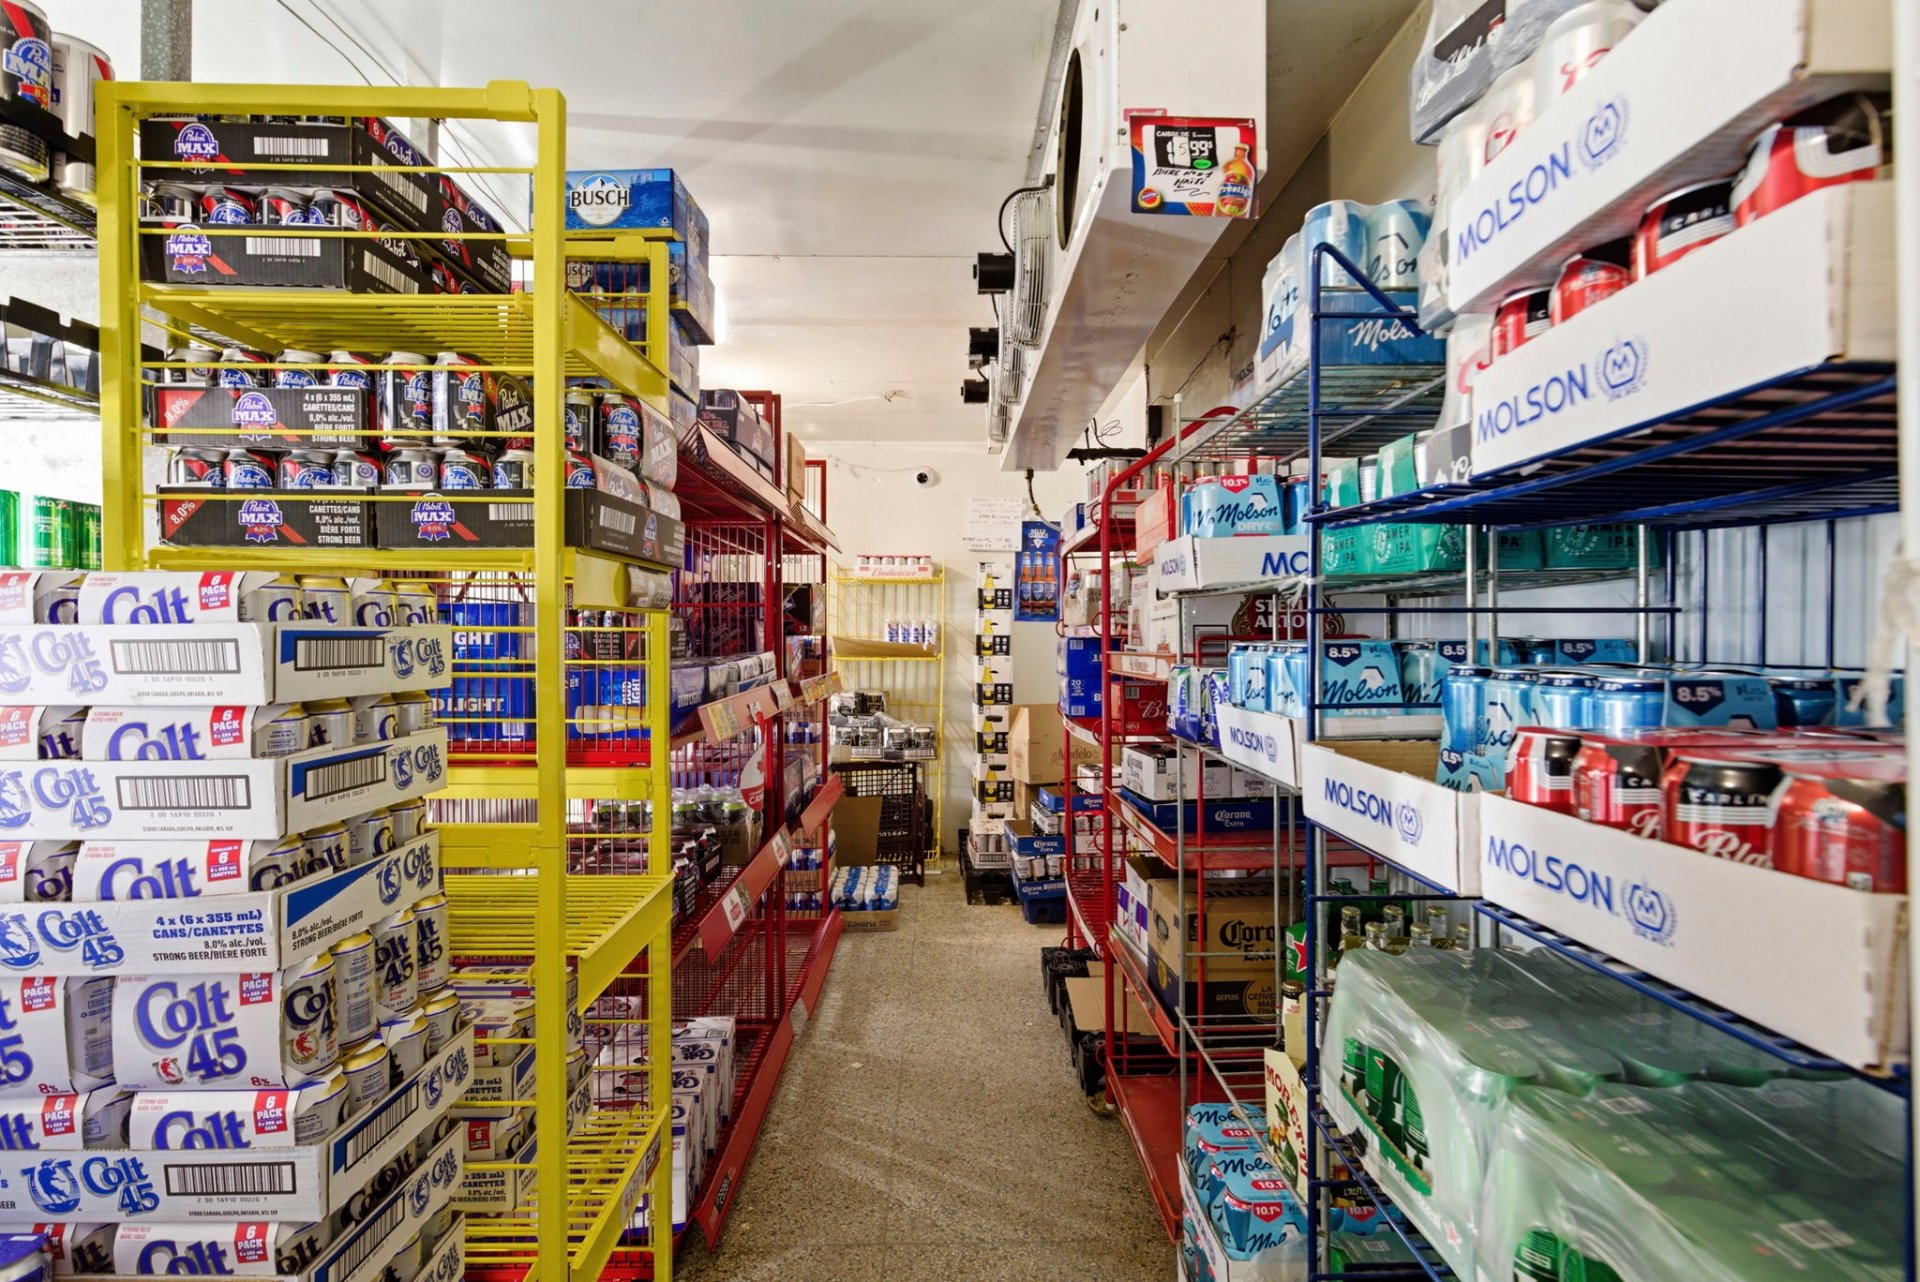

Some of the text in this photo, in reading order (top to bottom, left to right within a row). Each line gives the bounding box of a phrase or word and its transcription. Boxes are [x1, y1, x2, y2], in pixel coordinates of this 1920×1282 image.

[186, 130, 207, 142] Pabst
[177, 142, 217, 154] MAX
[571, 189, 630, 209] BUSCH
[1456, 142, 1570, 266] MOLSON
[1670, 201, 1728, 231] CARL
[170, 243, 209, 255] MAX
[337, 373, 363, 388] Pabst
[164, 397, 190, 423] 8.0%
[241, 400, 263, 412] Pabst
[303, 403, 355, 412] CANETTES/CANS
[1476, 363, 1590, 446] MOLSON
[234, 411, 274, 422] MAX
[497, 407, 530, 431] MAX
[606, 423, 640, 436] MAX
[235, 472, 260, 485] Pabst
[1222, 478, 1248, 487] 10.1%
[170, 500, 195, 525] 8.0%
[249, 502, 270, 512] Pabst
[309, 506, 360, 514] CANETTES/CANS
[1214, 503, 1279, 525] Molson
[241, 512, 279, 523] MAX
[413, 512, 452, 522] MAX
[341, 525, 360, 533] FORTE
[1237, 521, 1263, 532] DRY
[343, 535, 360, 543] BEER
[1607, 537, 1636, 549] IPA
[1396, 541, 1411, 554] IPA
[871, 567, 917, 578] Budweiser
[211, 575, 221, 586] 6
[201, 585, 227, 596] PACK
[454, 632, 494, 646] GHT
[31, 630, 96, 674] Colt
[415, 637, 443, 666] Colt
[1329, 646, 1360, 658] 8.5%
[1443, 644, 1467, 656] 8.5
[1563, 642, 1594, 653] 8.5%
[429, 656, 446, 675] 45
[69, 659, 109, 697] 45
[1323, 679, 1399, 704] Molson
[1677, 685, 1719, 702] 8.5%
[447, 697, 505, 712] LIGHT
[10, 711, 20, 722] 6
[222, 709, 234, 721] 6
[0, 720, 27, 732] PACK
[213, 720, 240, 732] PACK
[1229, 726, 1264, 754] MOLSON
[414, 743, 439, 774] Colt
[1441, 750, 1462, 765] 8.5%
[427, 760, 443, 783] 45
[32, 767, 101, 810] Colt
[1325, 777, 1392, 828] MOLSON
[71, 796, 113, 832] 45
[1215, 810, 1252, 821] Corona
[1033, 839, 1058, 847] Corona
[219, 852, 228, 863] 6
[402, 843, 431, 881] Colt
[416, 861, 434, 890] 45
[1487, 834, 1615, 912] MOLSON
[1022, 885, 1042, 893] Corona
[156, 916, 165, 925] 4
[180, 914, 194, 926] (6
[196, 917, 204, 925] x
[207, 913, 233, 924] 355
[237, 909, 263, 922] mL)
[36, 908, 110, 951] Colt
[153, 923, 264, 939] CANS/CANETTES
[292, 915, 334, 940] 8.0% alc./vol.
[292, 910, 364, 951] STRONG BEER/BIÈRE FORTE
[204, 937, 267, 950] 8.0% alc./vol.
[82, 934, 126, 971] 45
[153, 947, 268, 962] STRONG BEER/BIÈRE FORTE
[417, 939, 444, 967] 45
[385, 954, 415, 988] 45
[23, 984, 51, 997] PACK
[242, 977, 270, 990] PACK
[134, 980, 235, 1050] Colt
[186, 1027, 248, 1082] 45
[444, 1046, 466, 1080] Colt
[54, 1097, 64, 1110] 6
[265, 1095, 276, 1109] 6
[44, 1110, 71, 1122] PACK
[256, 1108, 283, 1121] PACK
[476, 1131, 482, 1139] 6
[432, 1147, 456, 1188] Colt
[80, 1156, 149, 1198] Colt
[118, 1183, 161, 1218] 45
[1254, 1205, 1281, 1216] 10.1%
[246, 1225, 256, 1239] 6
[237, 1238, 263, 1251] PACK
